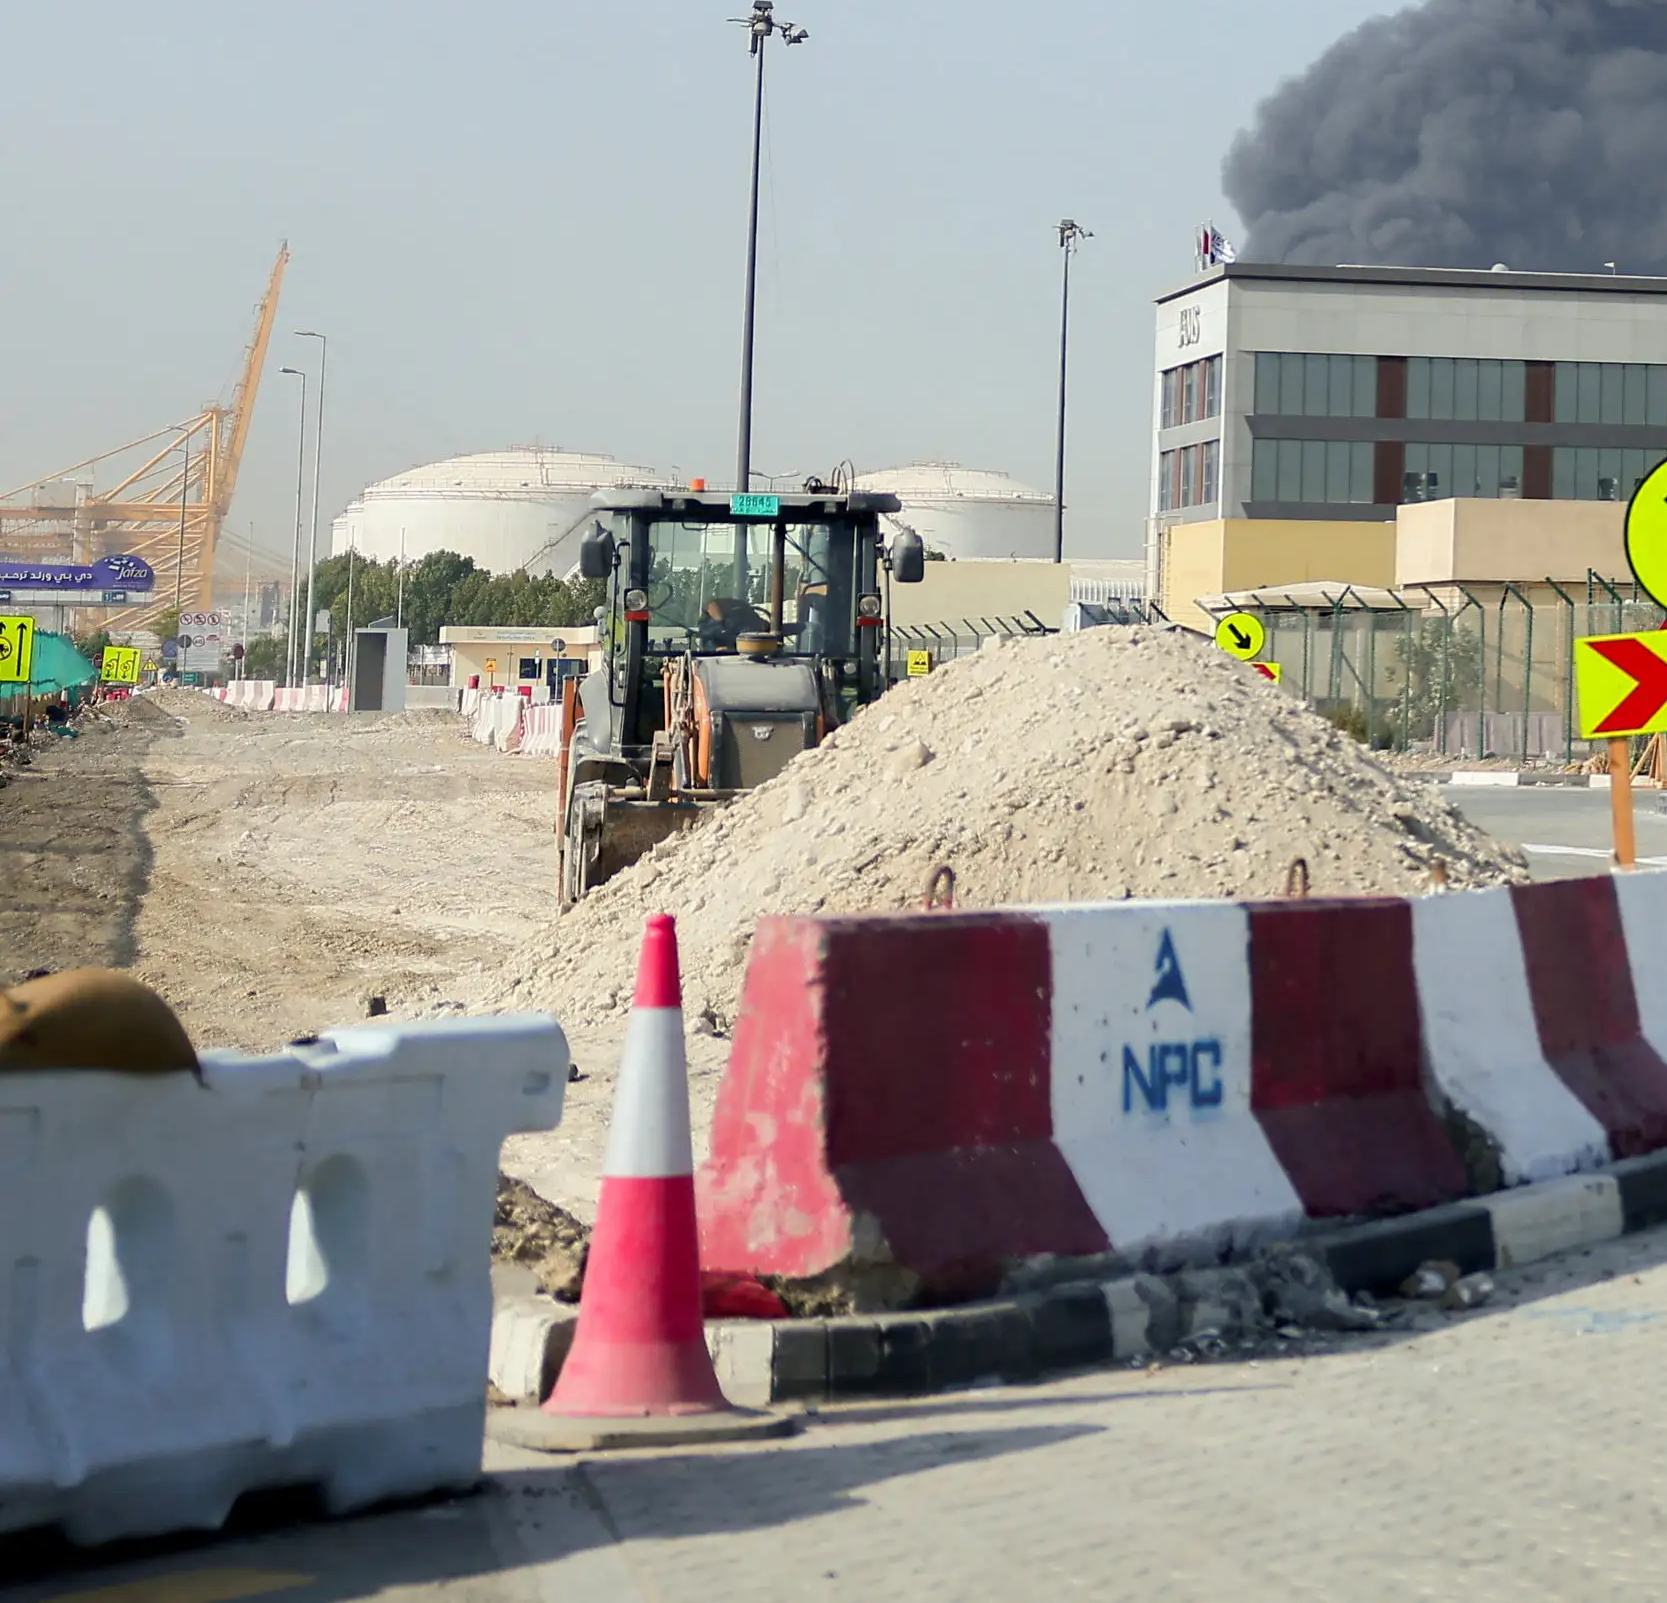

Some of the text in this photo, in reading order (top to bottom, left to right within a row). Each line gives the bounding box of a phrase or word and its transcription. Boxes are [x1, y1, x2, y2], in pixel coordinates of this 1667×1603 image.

[55, 572, 72, 584] بي
[75, 571, 92, 583] دي
[116, 566, 148, 580] Jafza
[1122, 1036, 1223, 1113] NPC
